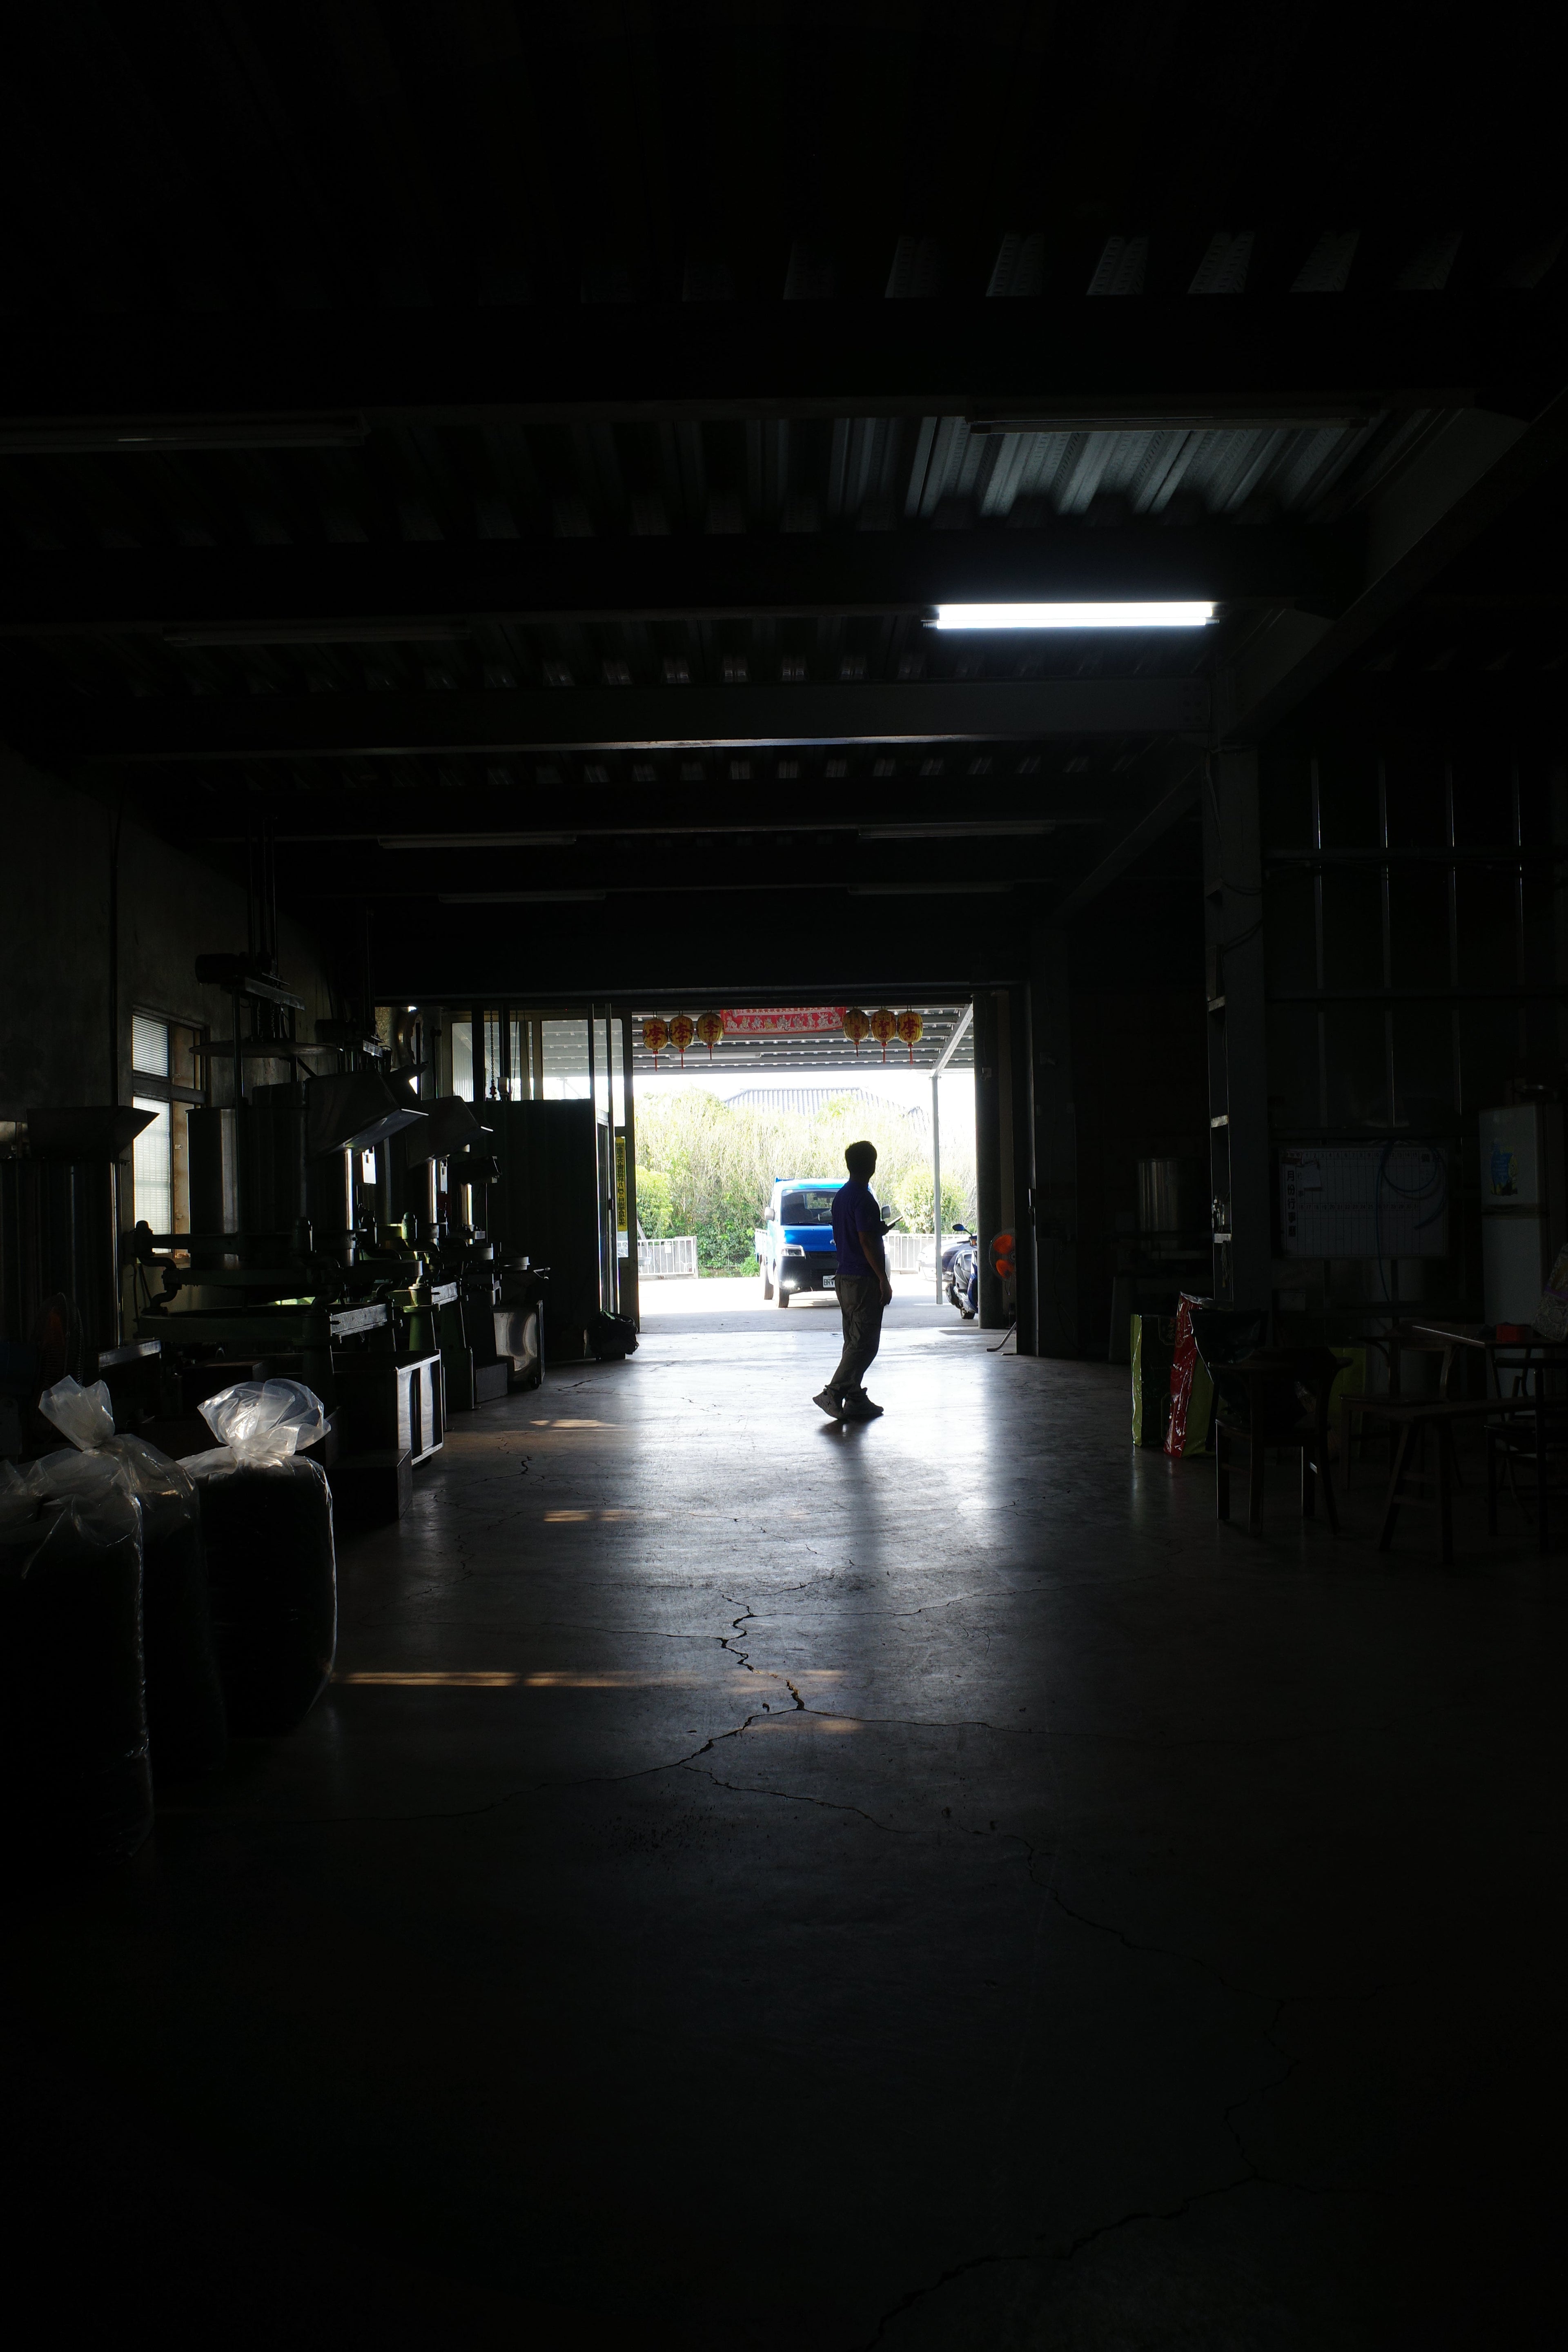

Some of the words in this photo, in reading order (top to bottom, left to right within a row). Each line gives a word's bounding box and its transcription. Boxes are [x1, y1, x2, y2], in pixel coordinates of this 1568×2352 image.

[646, 1025, 665, 1045] 李
[672, 1022, 692, 1043] 李
[878, 1020, 890, 1038] 聖母
[901, 1017, 919, 1038] 李
